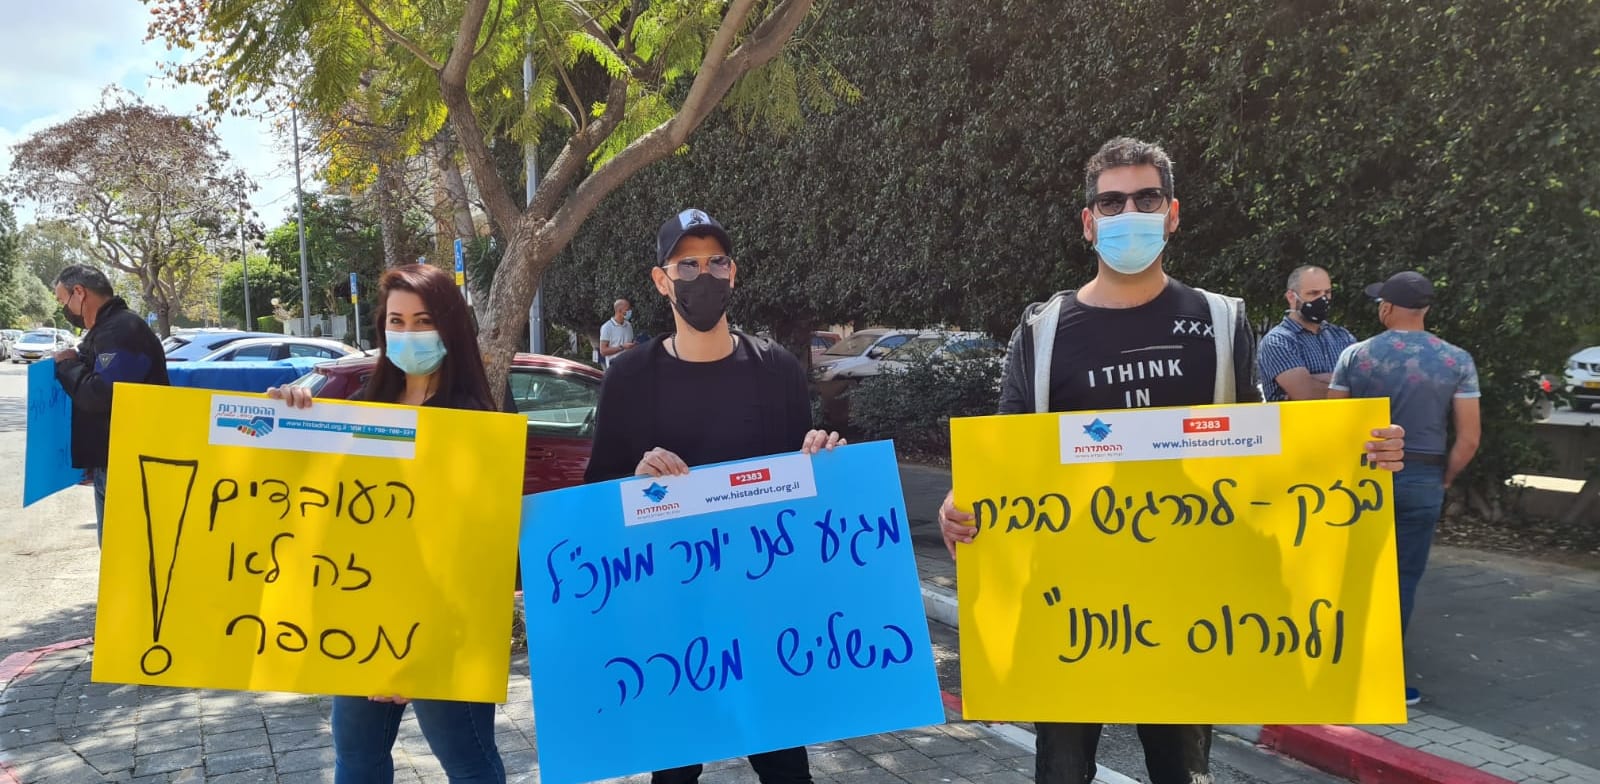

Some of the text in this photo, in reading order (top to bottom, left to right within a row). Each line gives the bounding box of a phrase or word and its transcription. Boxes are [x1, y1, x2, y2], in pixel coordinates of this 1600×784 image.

[1088, 358, 1184, 388] I THINK
[218, 403, 275, 416] ההסתדרות
[1125, 388, 1150, 408] IN
[1074, 444, 1123, 453] ההסתדרות
[1153, 435, 1263, 449] www.histadrut.org.il
[209, 478, 415, 532] העובדים
[636, 502, 680, 516] ההסתדרות
[705, 481, 800, 503] www.histadrut.org.il
[972, 492, 1072, 538] בבית
[1090, 478, 1238, 543] להרגיש
[228, 532, 372, 591] זה לא
[547, 507, 901, 615] מגיע לנו יותר ממנכ"ל
[226, 614, 420, 664] מספר
[776, 611, 914, 676] בשליש
[1187, 598, 1345, 665] ולהרוס
